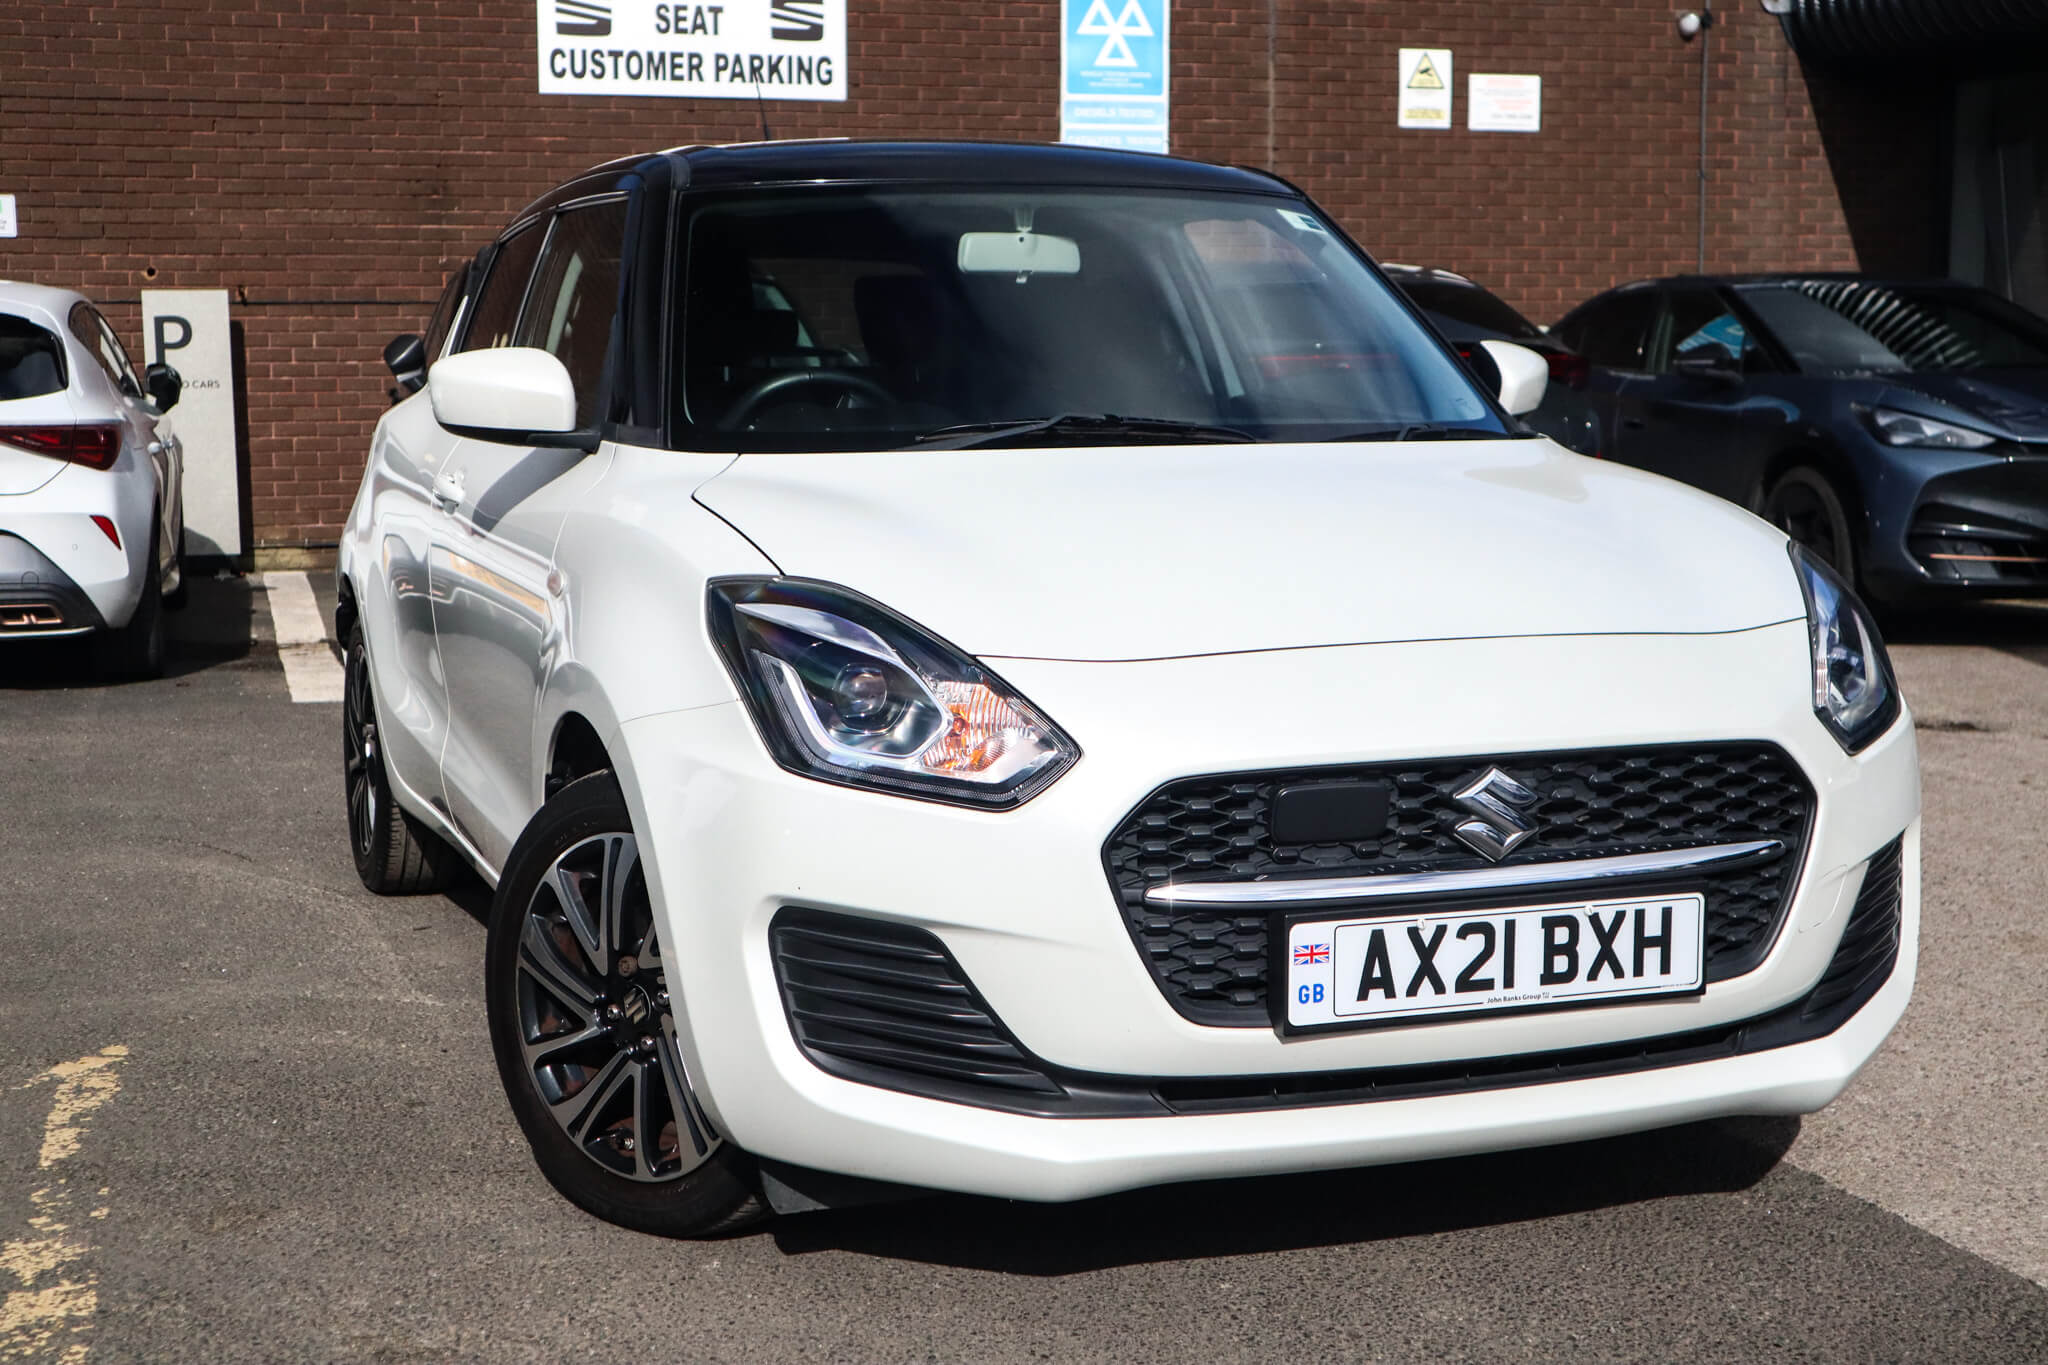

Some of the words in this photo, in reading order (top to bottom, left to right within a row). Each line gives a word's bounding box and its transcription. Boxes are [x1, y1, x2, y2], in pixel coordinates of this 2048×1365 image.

[655, 5, 723, 35] SEAT
[550, 48, 704, 82] CUSTOMER
[714, 53, 833, 85] PARKING
[154, 315, 193, 364] P
[191, 379, 221, 390] CARS
[1356, 918, 1517, 1002] AX21
[1540, 906, 1673, 986] BXH
[1298, 983, 1325, 1004] GB
[1487, 996, 1502, 1004] John
[1522, 993, 1541, 1001] Group
